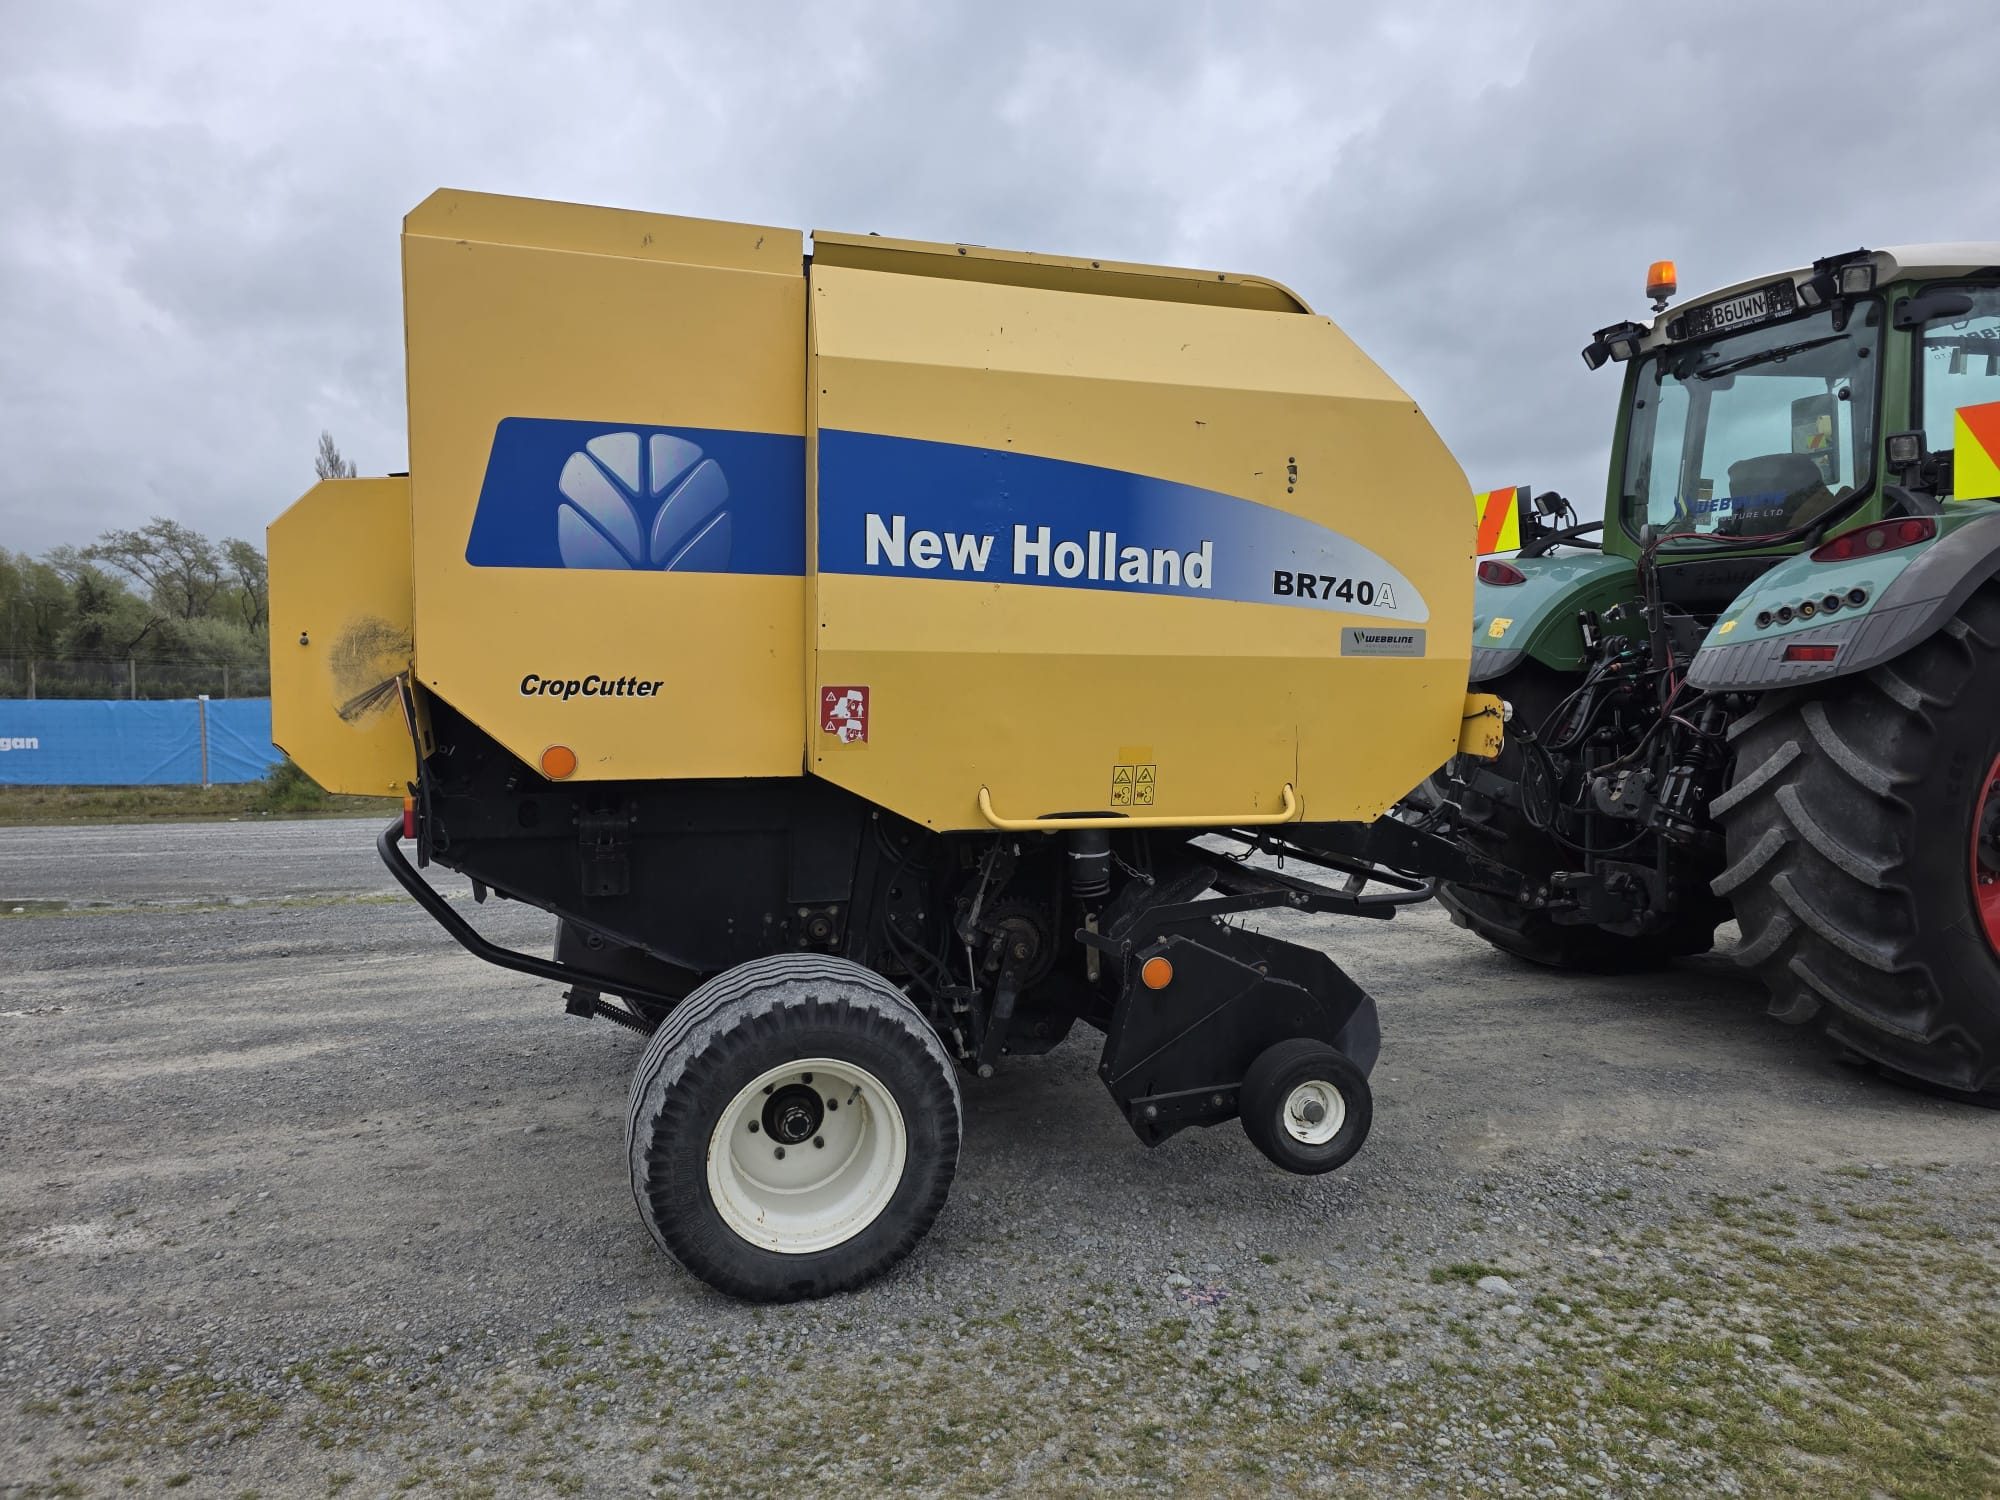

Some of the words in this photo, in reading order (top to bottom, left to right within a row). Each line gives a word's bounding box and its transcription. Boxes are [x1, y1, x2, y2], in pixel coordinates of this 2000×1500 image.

[1715, 296, 1764, 325] B6UWN
[1763, 508, 1784, 517] LTD
[865, 513, 994, 573] New
[1012, 524, 1213, 590] Holland
[1272, 570, 1397, 610] BR740A
[1365, 636, 1414, 644] WEBBLINE
[519, 673, 665, 701] CropCutter
